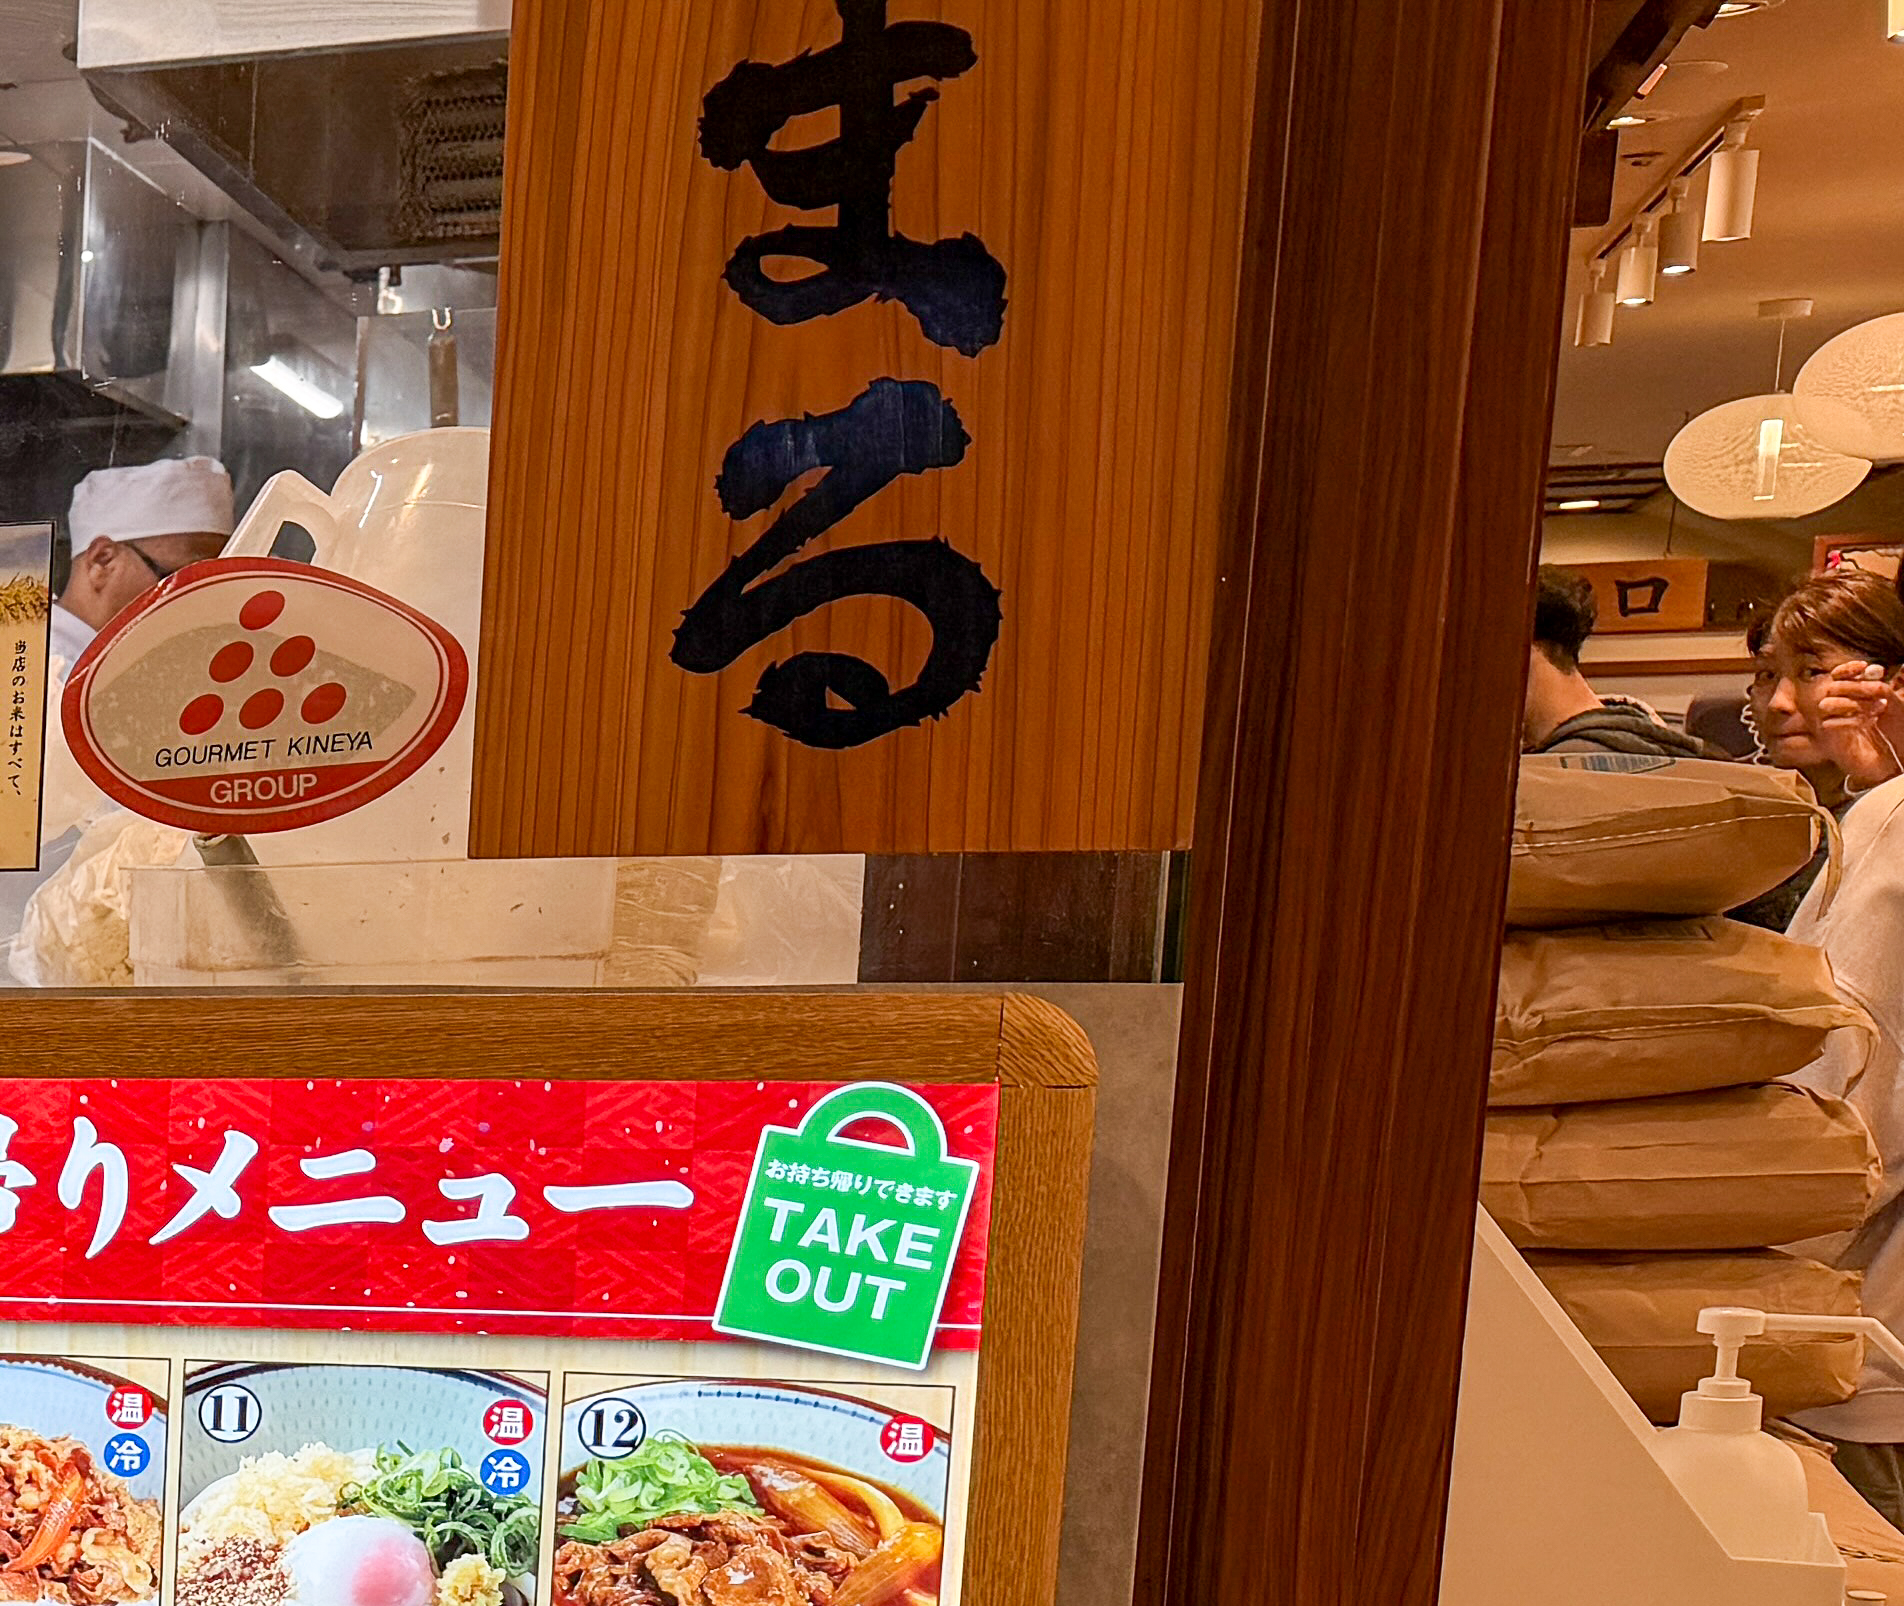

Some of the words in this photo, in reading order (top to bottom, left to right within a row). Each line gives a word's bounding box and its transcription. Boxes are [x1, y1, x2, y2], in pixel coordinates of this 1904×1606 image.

[155, 739, 276, 767] GOURMET
[287, 731, 373, 757] KINEYA
[210, 774, 318, 803] GROUP
[765, 1158, 958, 1211] お持ち帰りできます
[764, 1196, 941, 1270] TAKE
[765, 1259, 907, 1320] OUT
